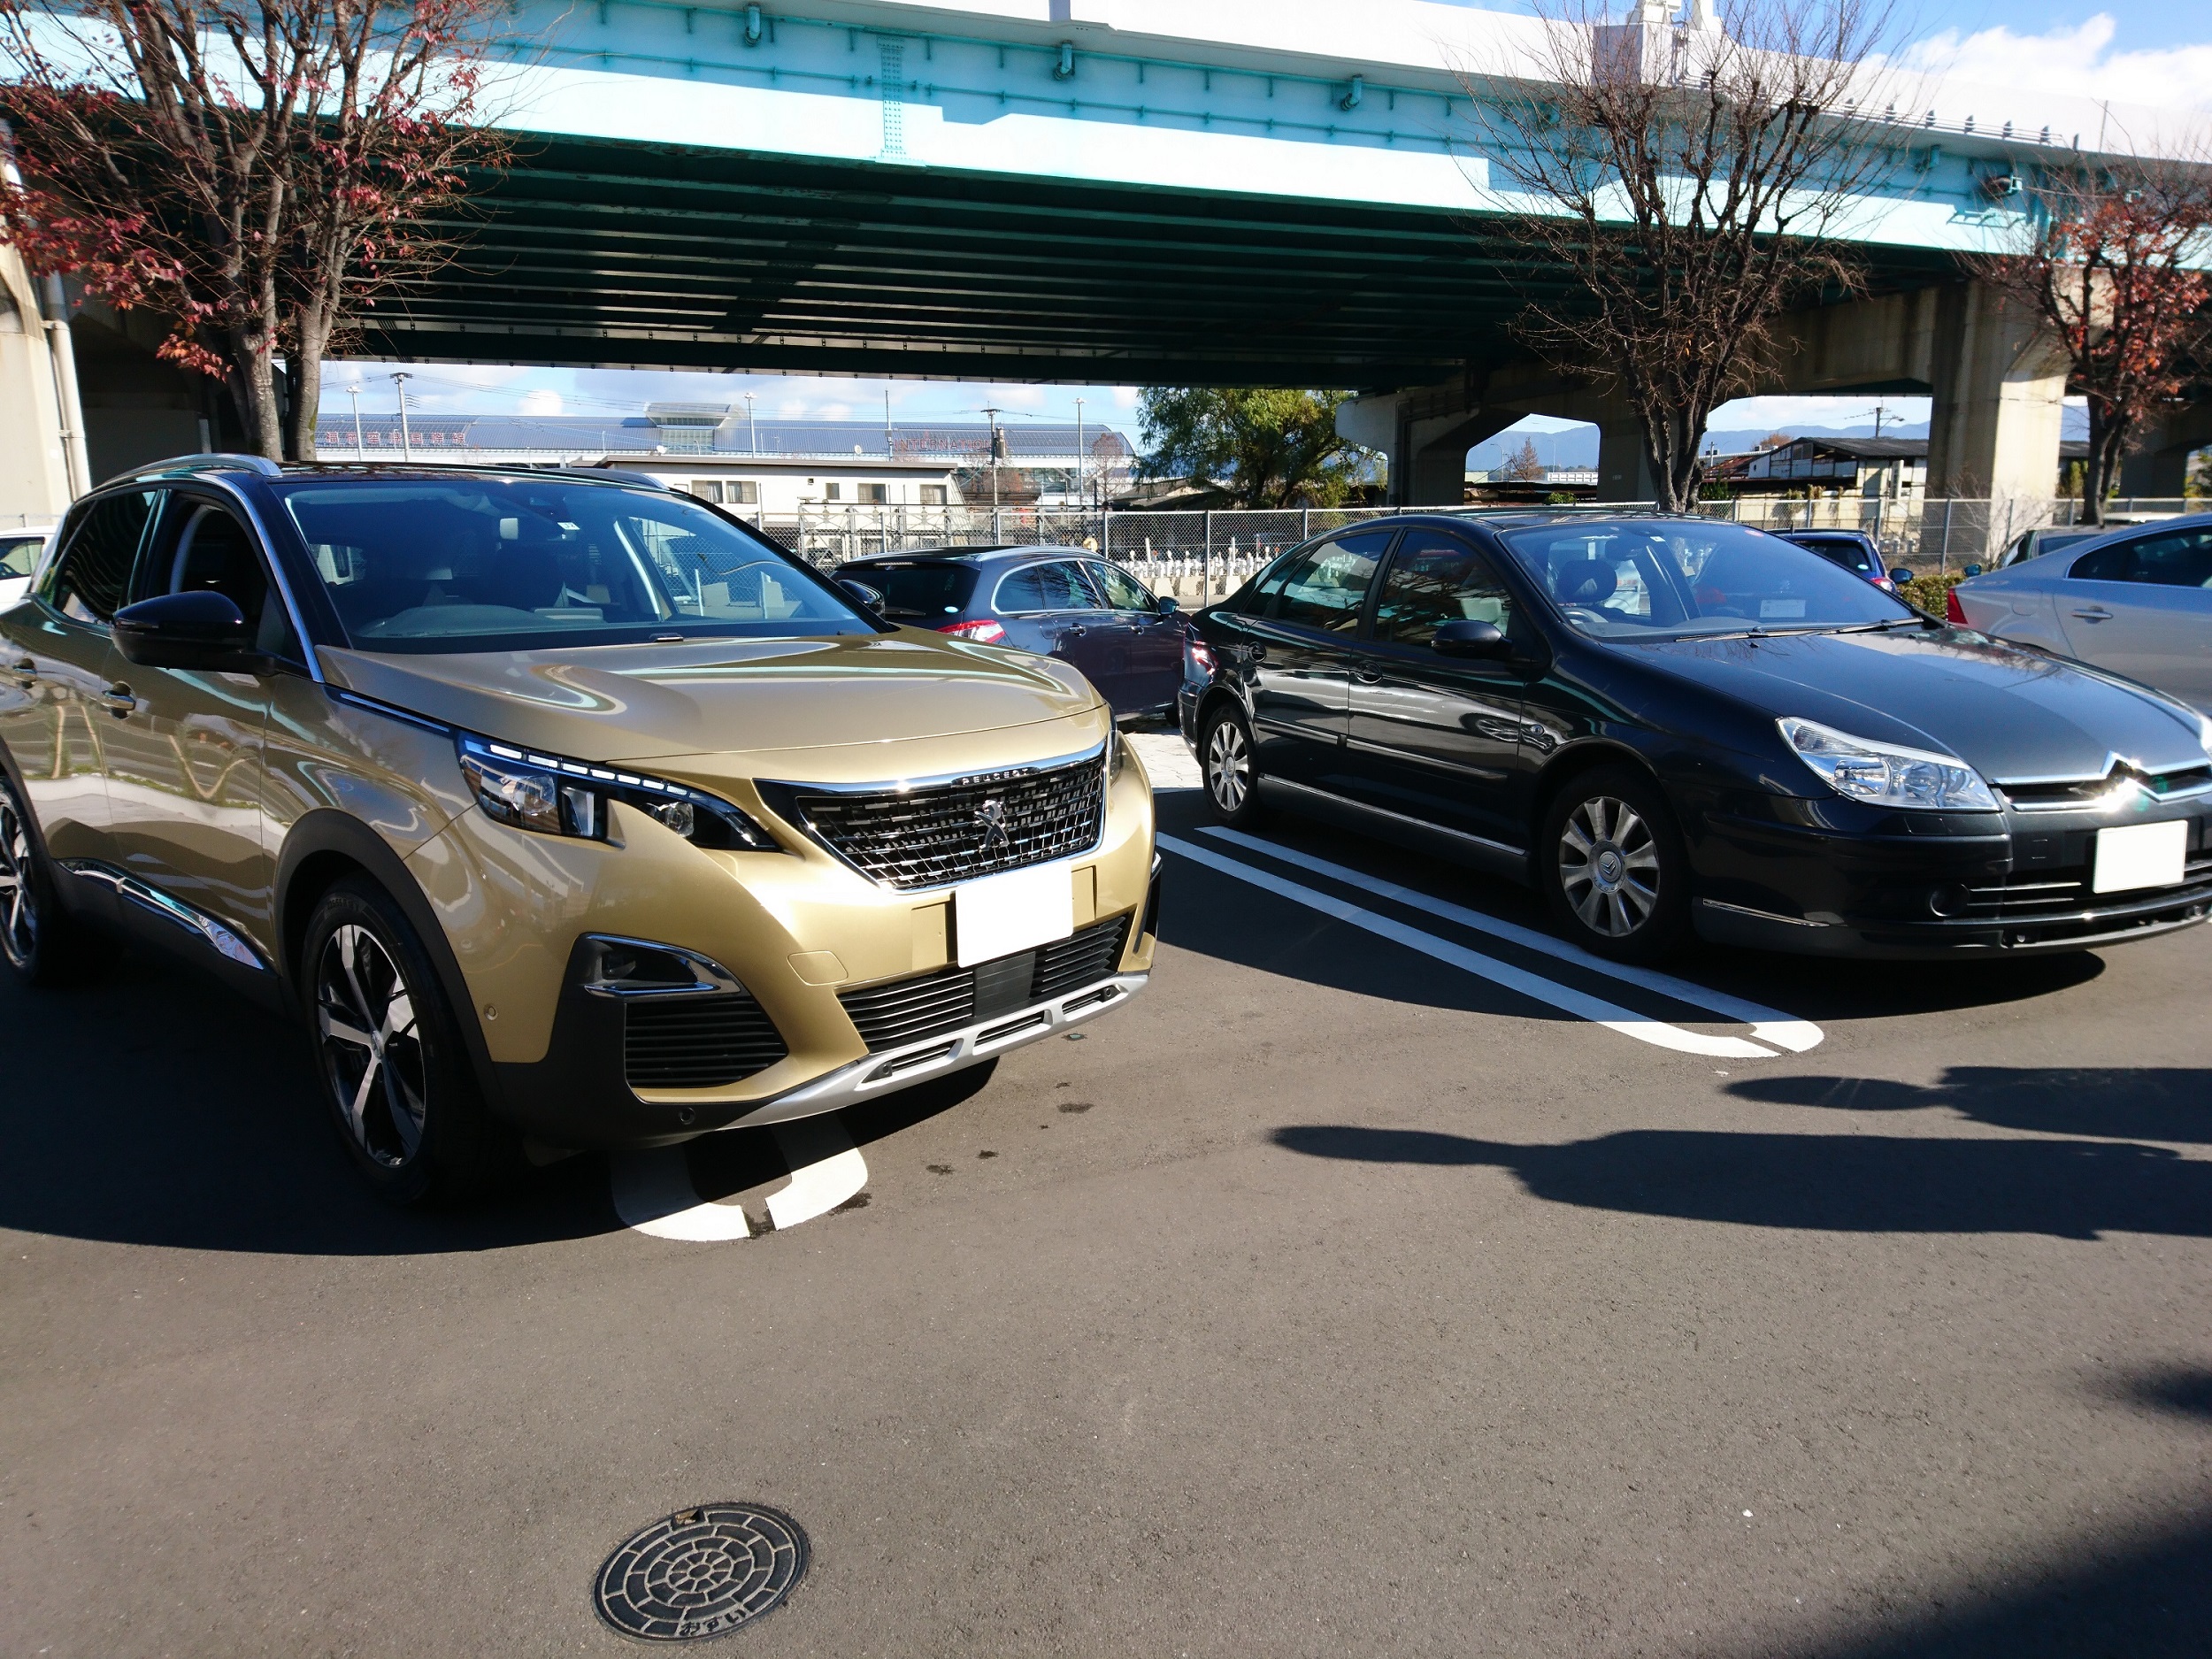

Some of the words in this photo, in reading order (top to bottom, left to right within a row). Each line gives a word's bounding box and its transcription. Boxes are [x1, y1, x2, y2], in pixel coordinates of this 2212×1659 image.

[894, 438, 1009, 450] INTERNATION
[962, 768, 1029, 785] PEUGEOT
[679, 1609, 747, 1636] おすい
